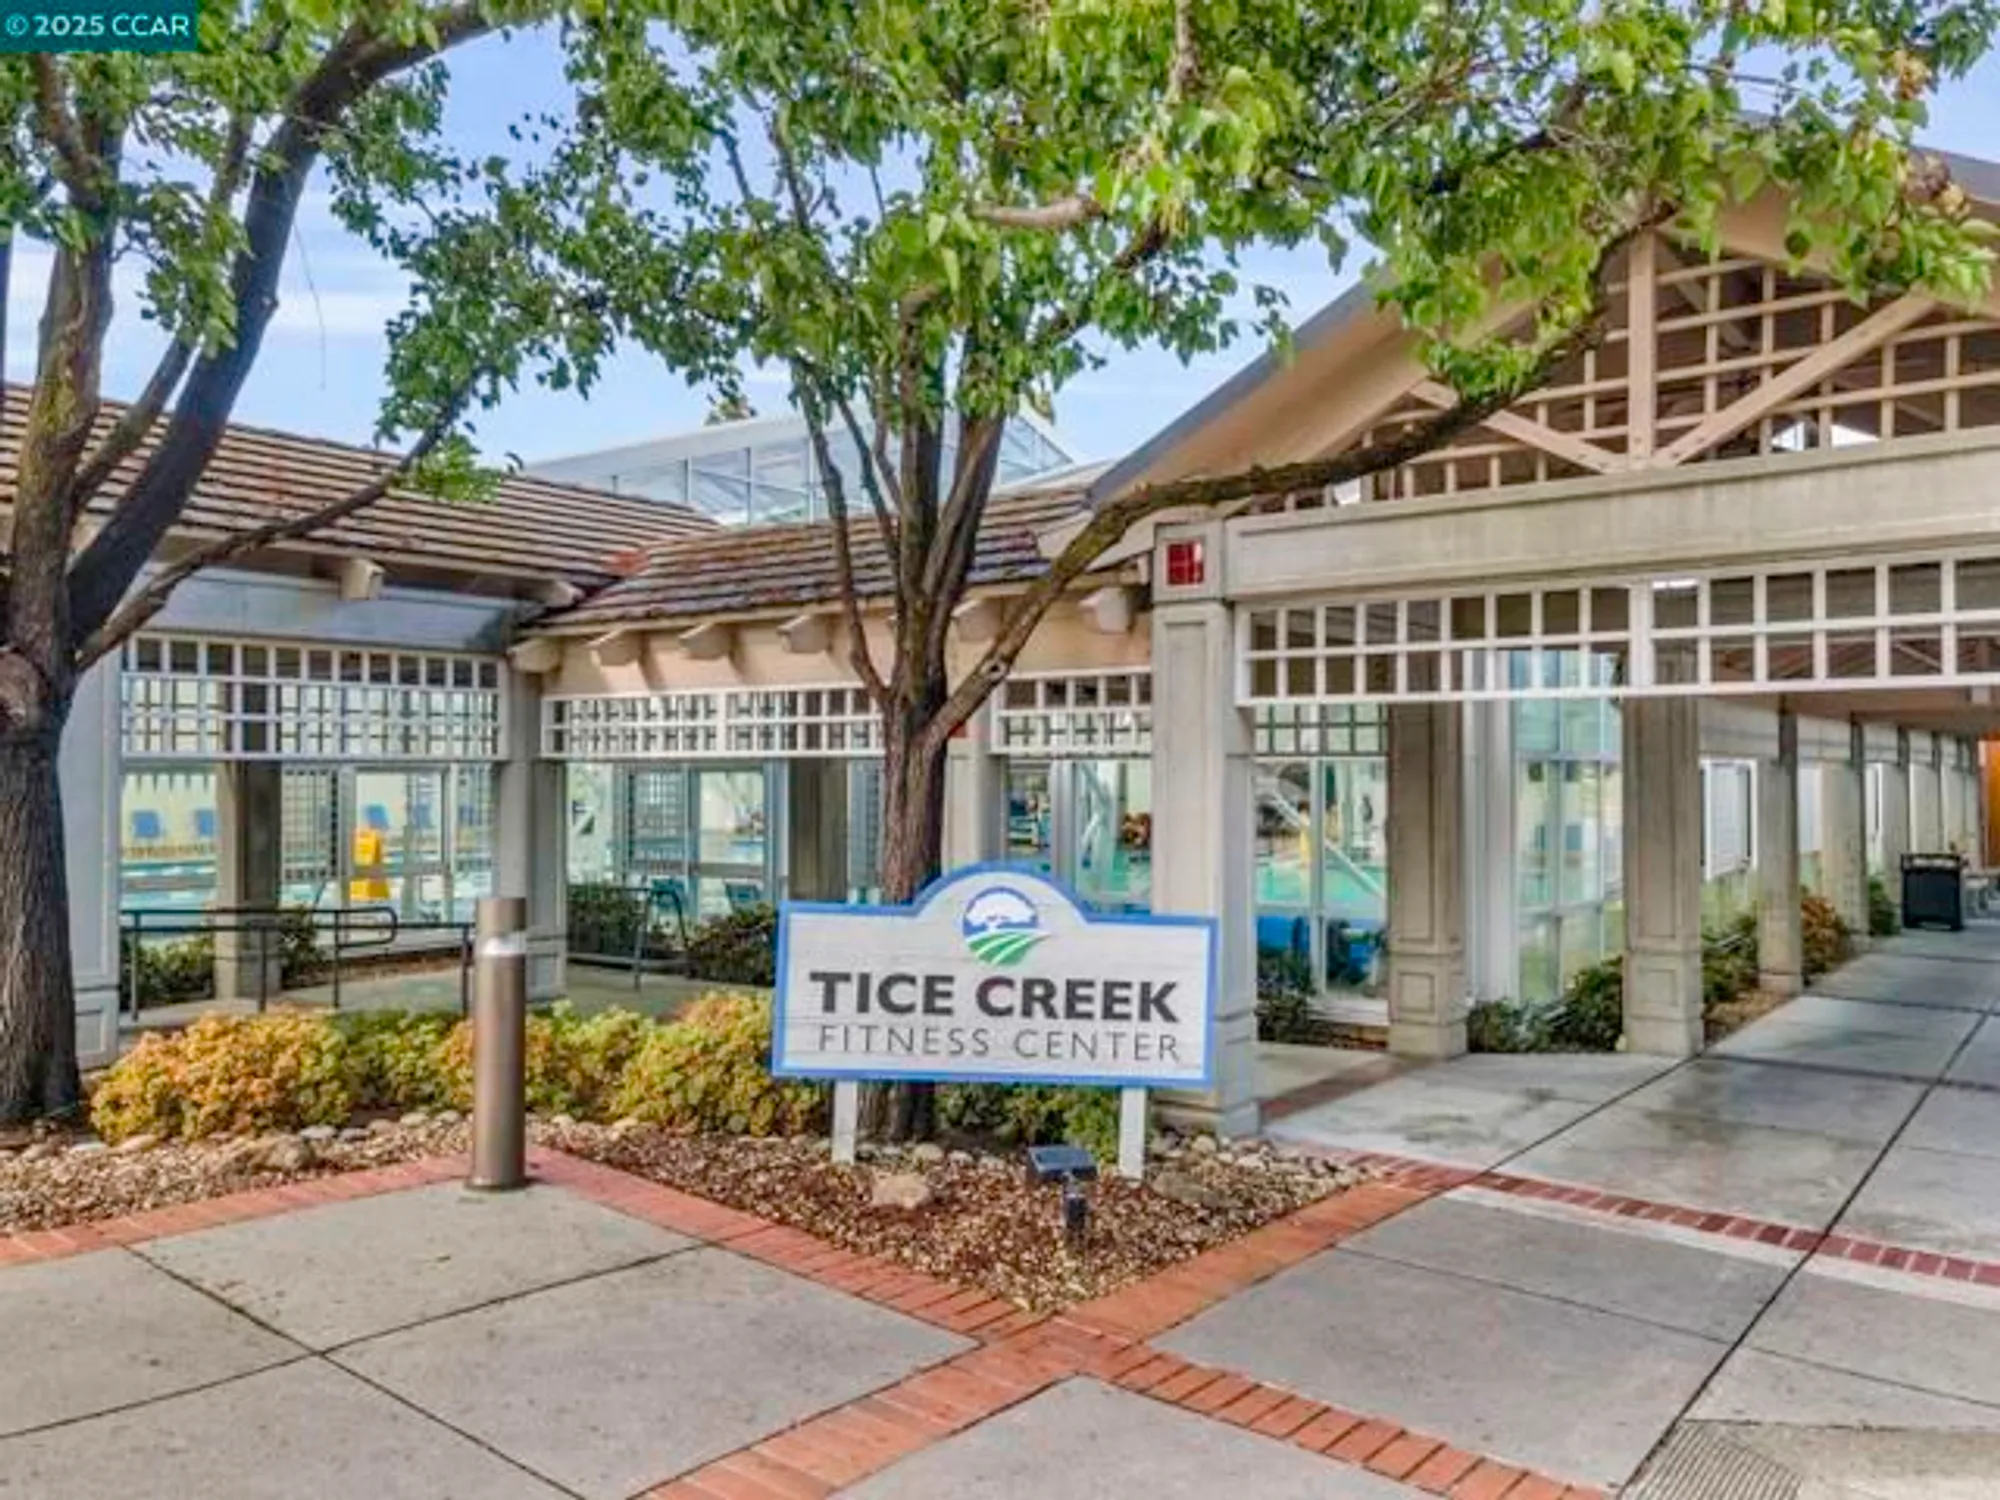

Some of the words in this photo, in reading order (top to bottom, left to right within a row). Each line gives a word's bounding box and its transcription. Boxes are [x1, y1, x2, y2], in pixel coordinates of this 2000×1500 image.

[809, 971, 955, 1017] TICE
[975, 976, 1179, 1023] CREEK
[818, 1024, 990, 1057] FITNESS
[1013, 1028, 1180, 1061] CENTER
